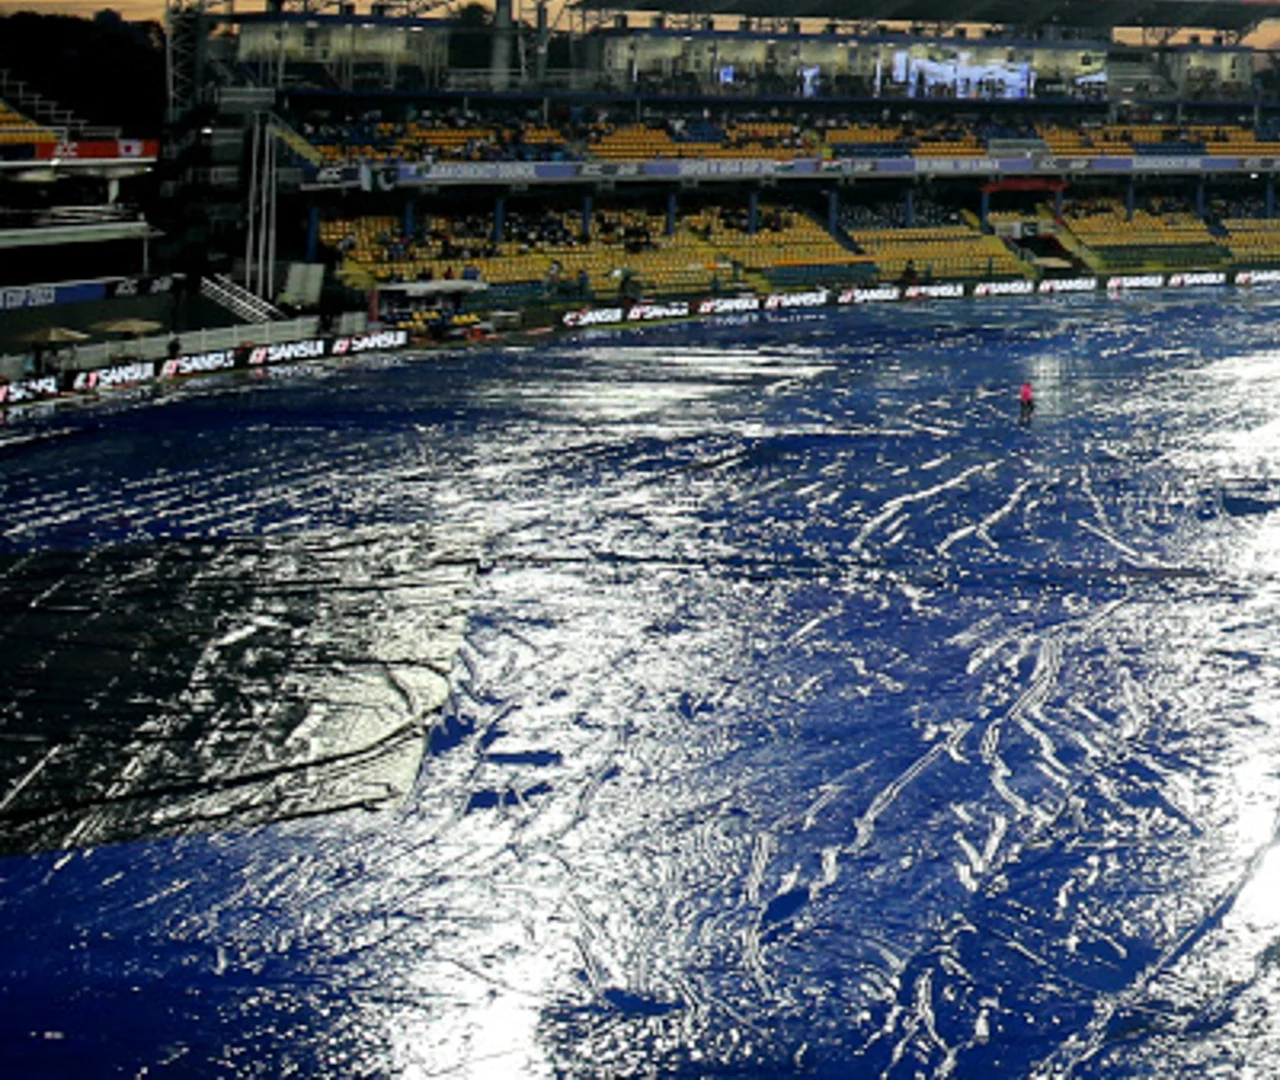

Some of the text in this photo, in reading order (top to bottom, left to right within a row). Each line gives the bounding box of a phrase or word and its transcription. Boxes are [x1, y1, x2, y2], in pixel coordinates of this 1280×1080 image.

[854, 288, 899, 302] SANSUI
[991, 280, 1034, 294] SANSUI
[715, 298, 759, 312] SANSUI
[781, 291, 826, 307] SANSUI
[579, 308, 622, 325] SANSUI
[352, 331, 408, 352] SANSUI
[268, 340, 324, 361] SANSUI
[98, 363, 154, 384] SANSUI
